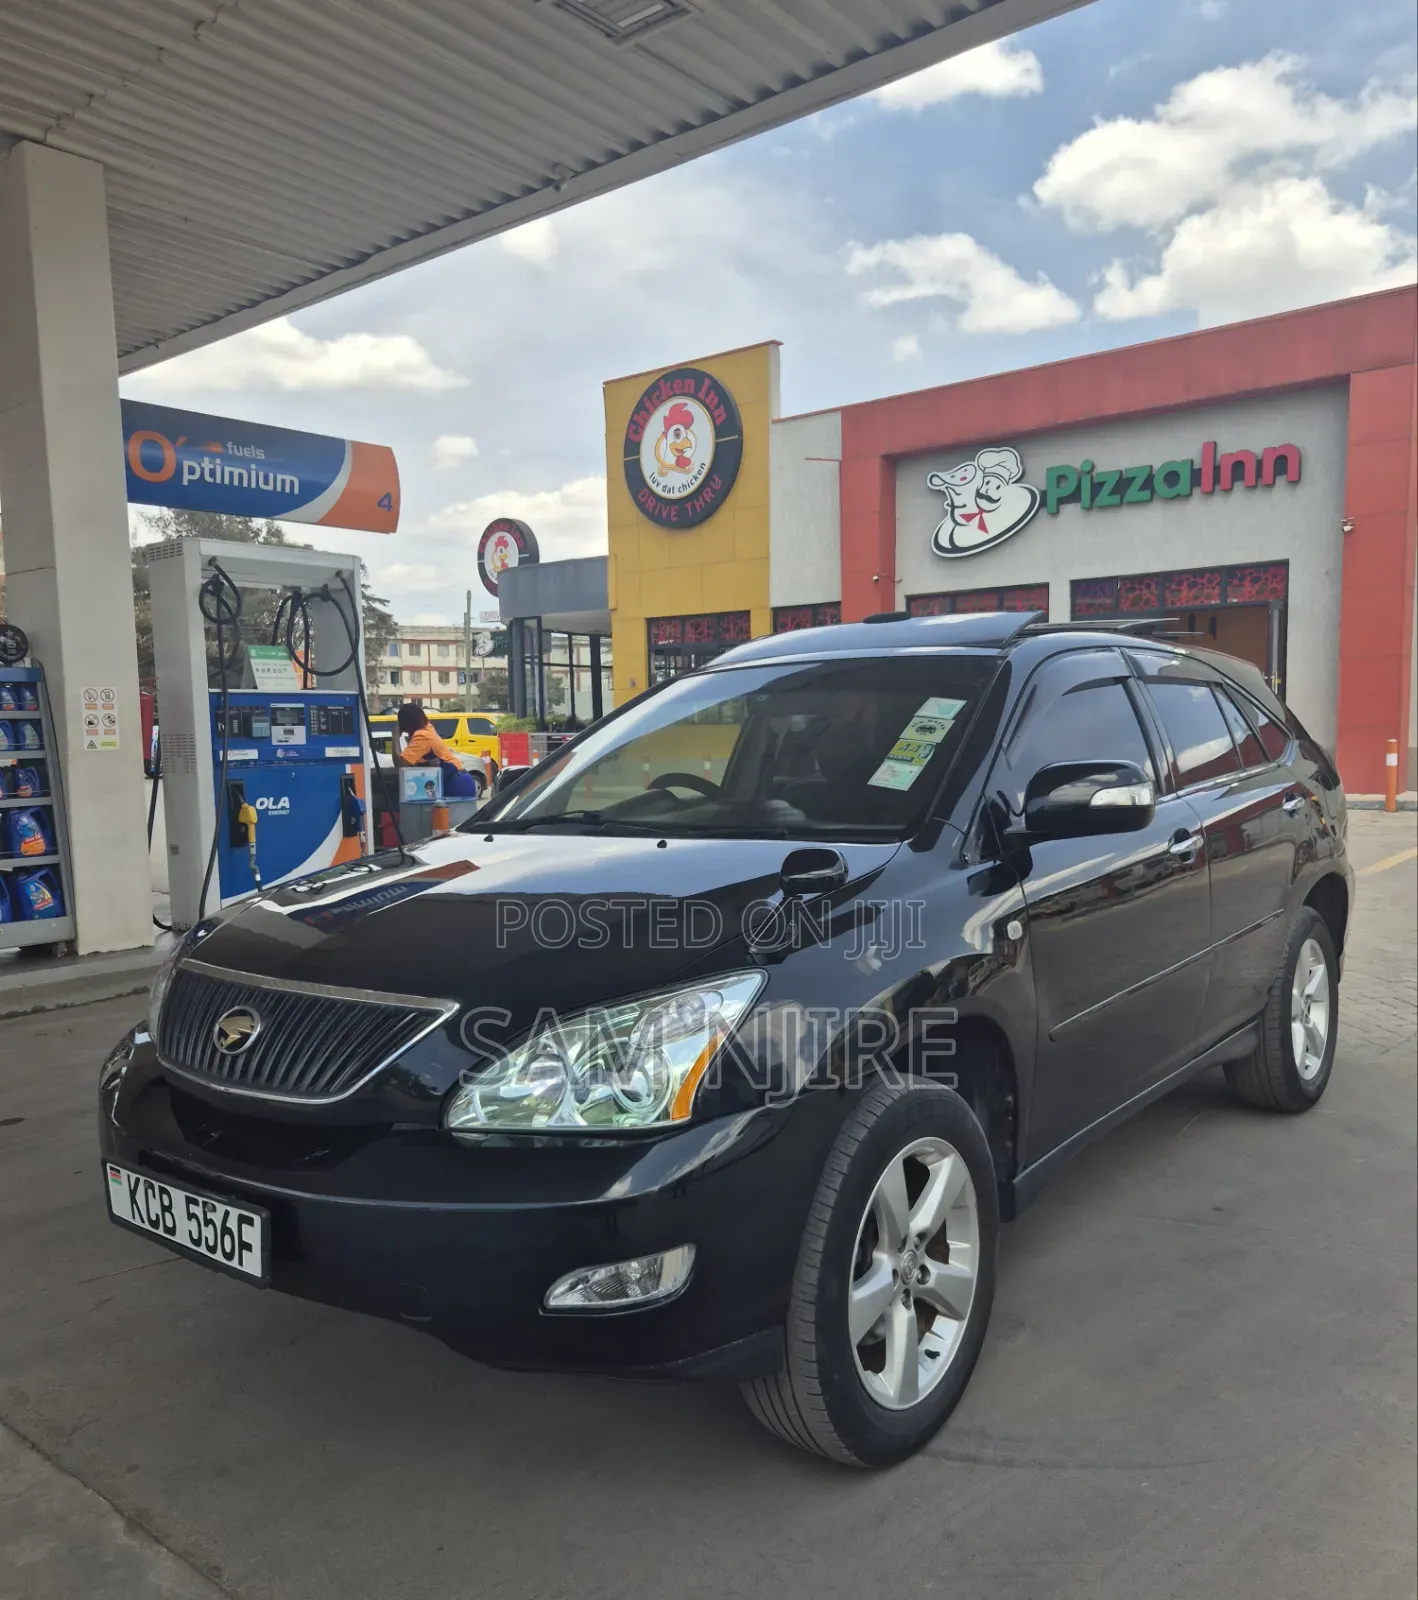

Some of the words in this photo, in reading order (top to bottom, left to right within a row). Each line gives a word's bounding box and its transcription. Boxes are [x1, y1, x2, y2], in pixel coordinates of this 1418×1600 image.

[628, 378, 695, 442] Chicken
[697, 378, 727, 426] Inn
[226, 441, 265, 460] fuels
[649, 471, 662, 488] luv
[661, 482, 675, 495] dat
[677, 462, 707, 495] chicken
[377, 492, 393, 512] 4
[638, 488, 679, 521] DRIVE
[684, 475, 722, 517] THRU
[255, 796, 290, 810] OLA
[127, 1173, 177, 1237] KCB
[185, 1194, 255, 1268] 556F
